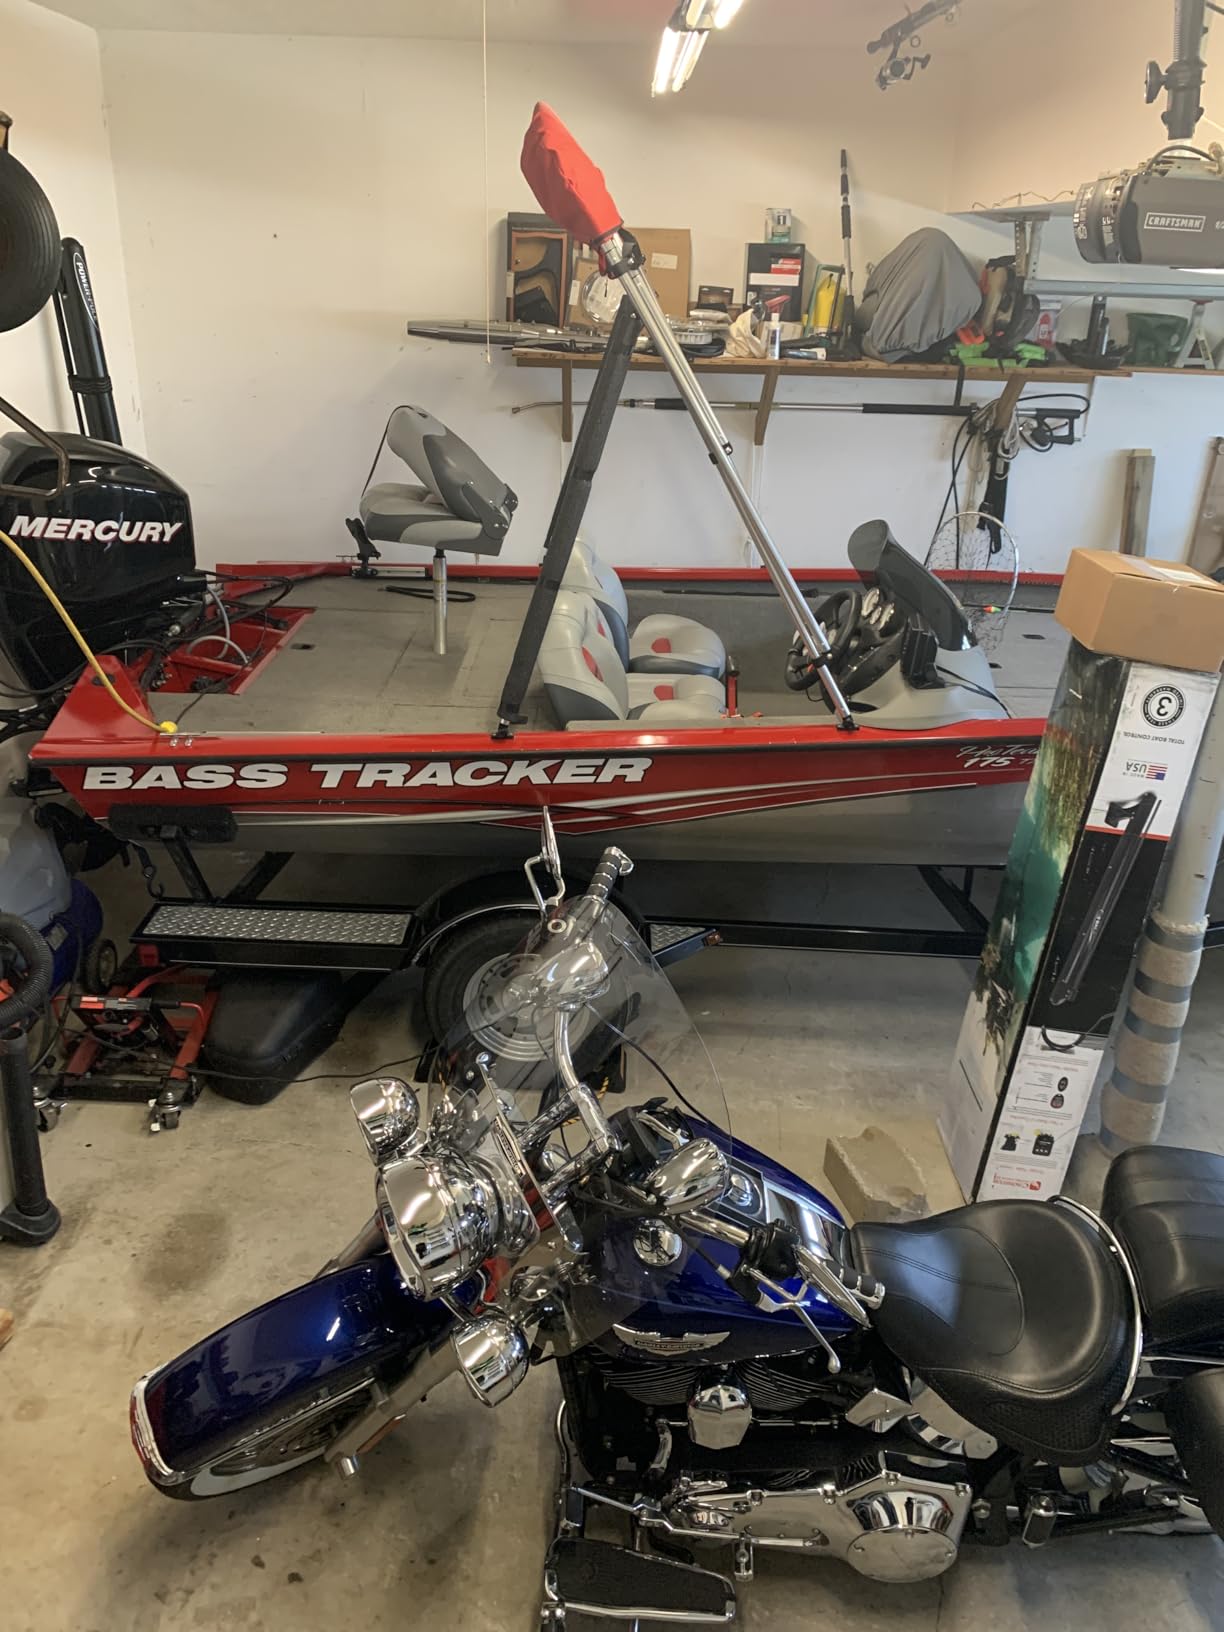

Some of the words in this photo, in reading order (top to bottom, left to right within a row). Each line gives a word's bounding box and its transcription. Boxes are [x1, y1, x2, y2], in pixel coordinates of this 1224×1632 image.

[1148, 215, 1203, 229] CRAFTSMAN
[8, 515, 183, 543] MERCURY
[1156, 696, 1172, 717] 3
[1123, 731, 1151, 741] CONTROL
[1151, 735, 1168, 743] BOAT
[1167, 737, 1185, 745] TOTAL
[963, 756, 1016, 769] 175
[1125, 761, 1147, 774] USA
[83, 763, 289, 791] BASS
[311, 756, 653, 788] TRACKER
